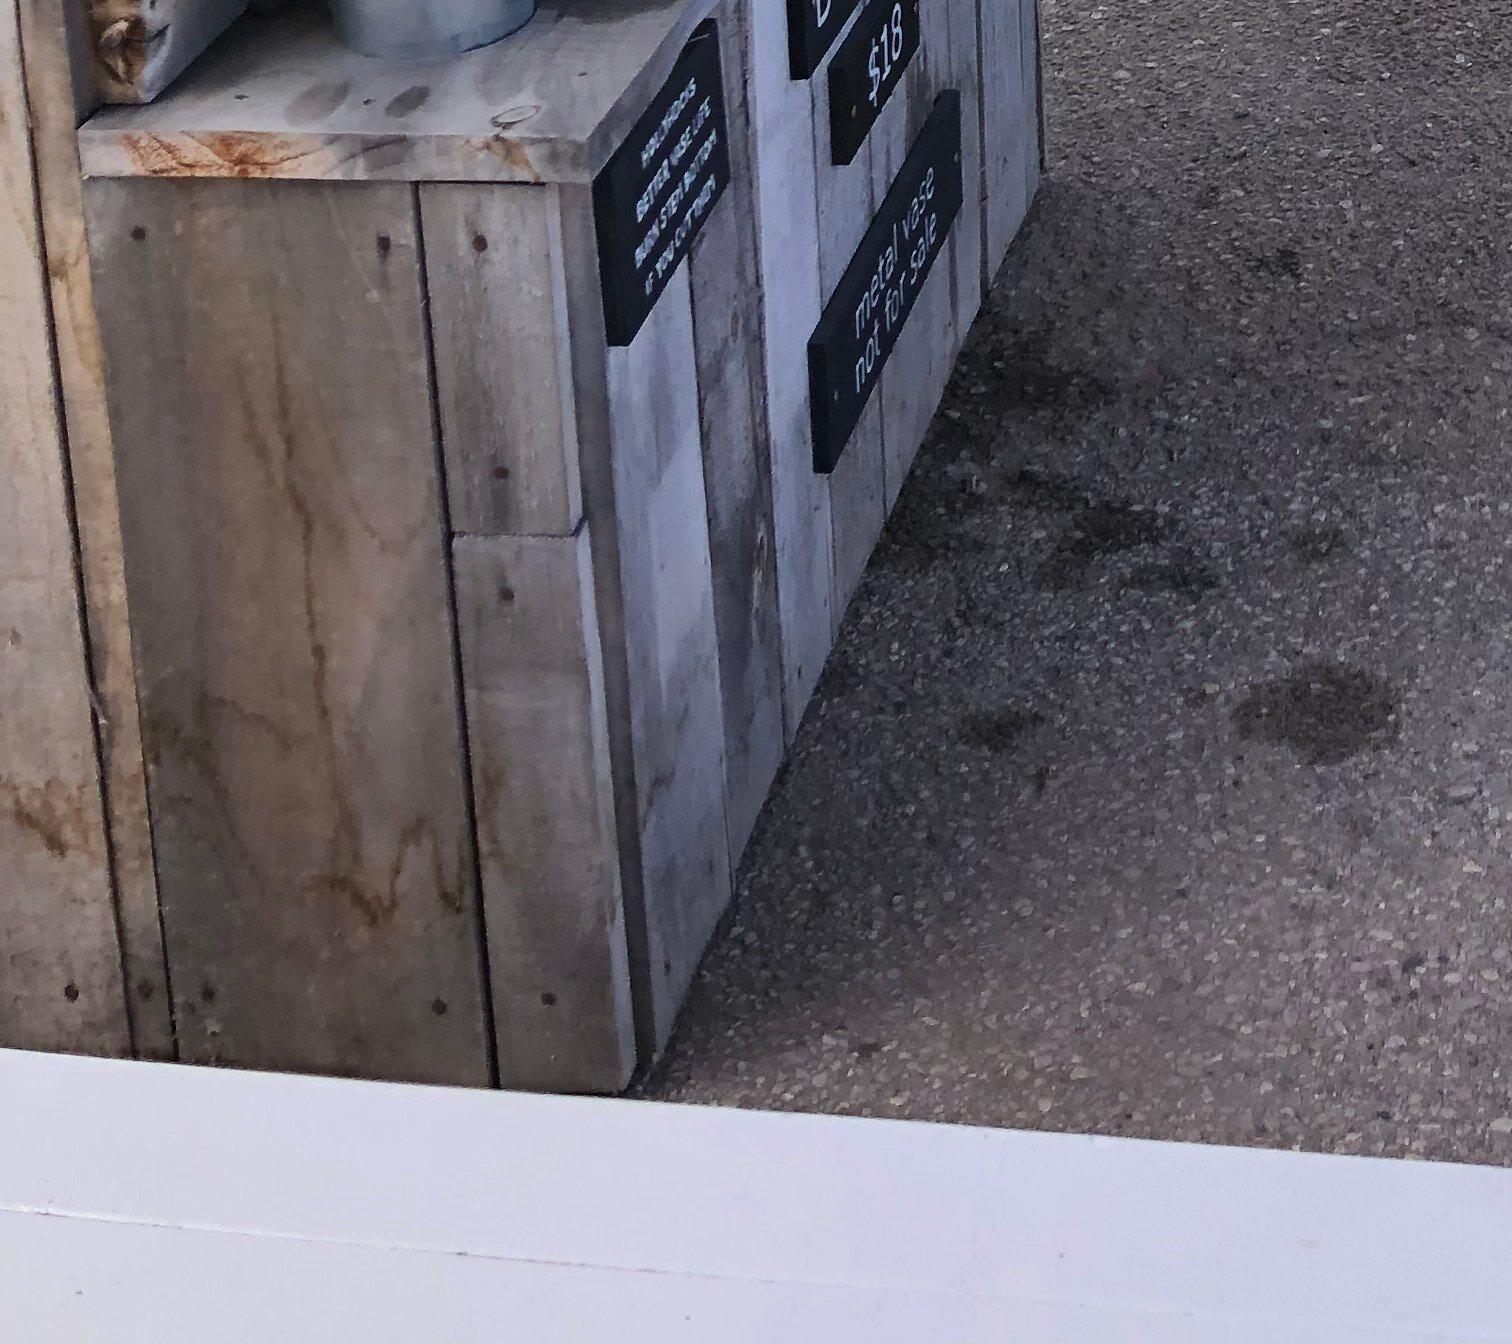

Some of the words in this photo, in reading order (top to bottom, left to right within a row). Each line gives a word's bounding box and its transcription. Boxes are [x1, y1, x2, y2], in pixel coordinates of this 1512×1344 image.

[867, 2, 904, 108] $18
[856, 222, 899, 340] metal
[902, 166, 935, 240] vase
[856, 317, 881, 394] not
[885, 270, 907, 332] for
[910, 212, 937, 285] sale
